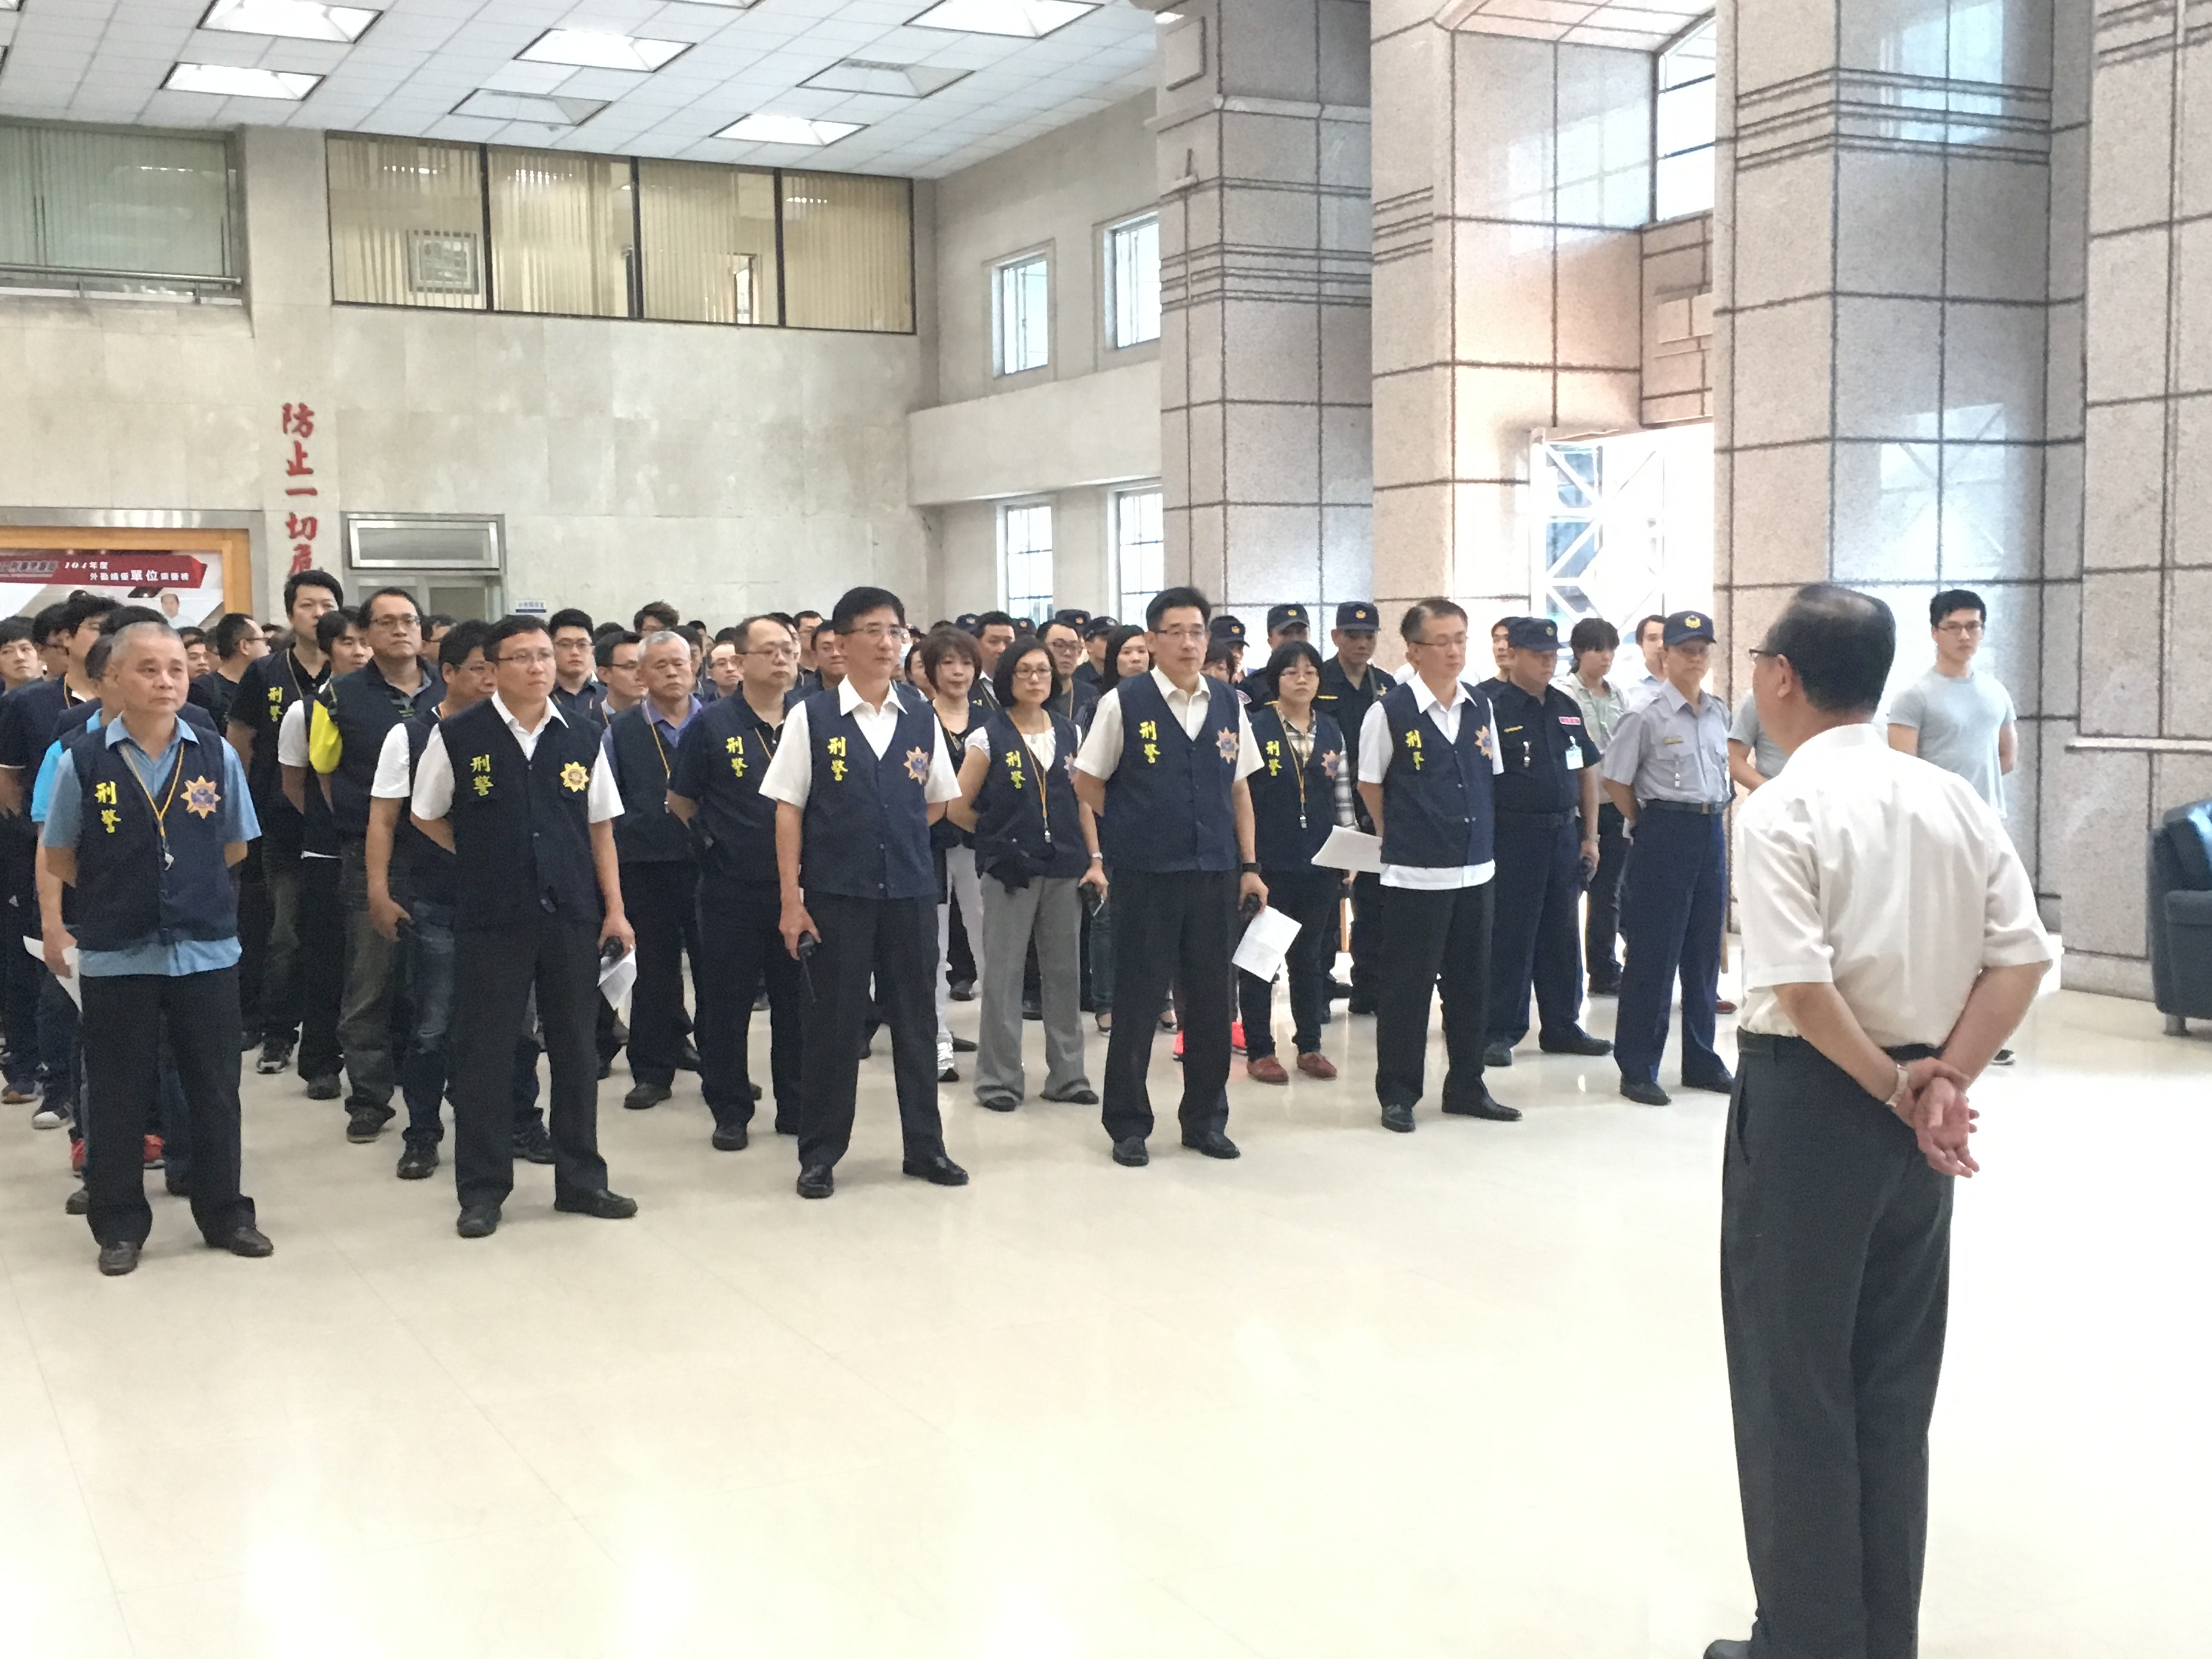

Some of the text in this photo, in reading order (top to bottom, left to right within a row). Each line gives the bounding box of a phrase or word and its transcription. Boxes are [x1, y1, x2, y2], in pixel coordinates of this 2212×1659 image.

[268, 686, 284, 721] 刑警
[726, 736, 748, 778] 刑警
[828, 736, 849, 781] 刑警
[1140, 721, 1161, 764] 刑警
[1266, 740, 1283, 777] 刑警
[471, 754, 493, 797] 刑警
[1006, 751, 1026, 789] 刑警
[94, 781, 122, 833] 刑警
